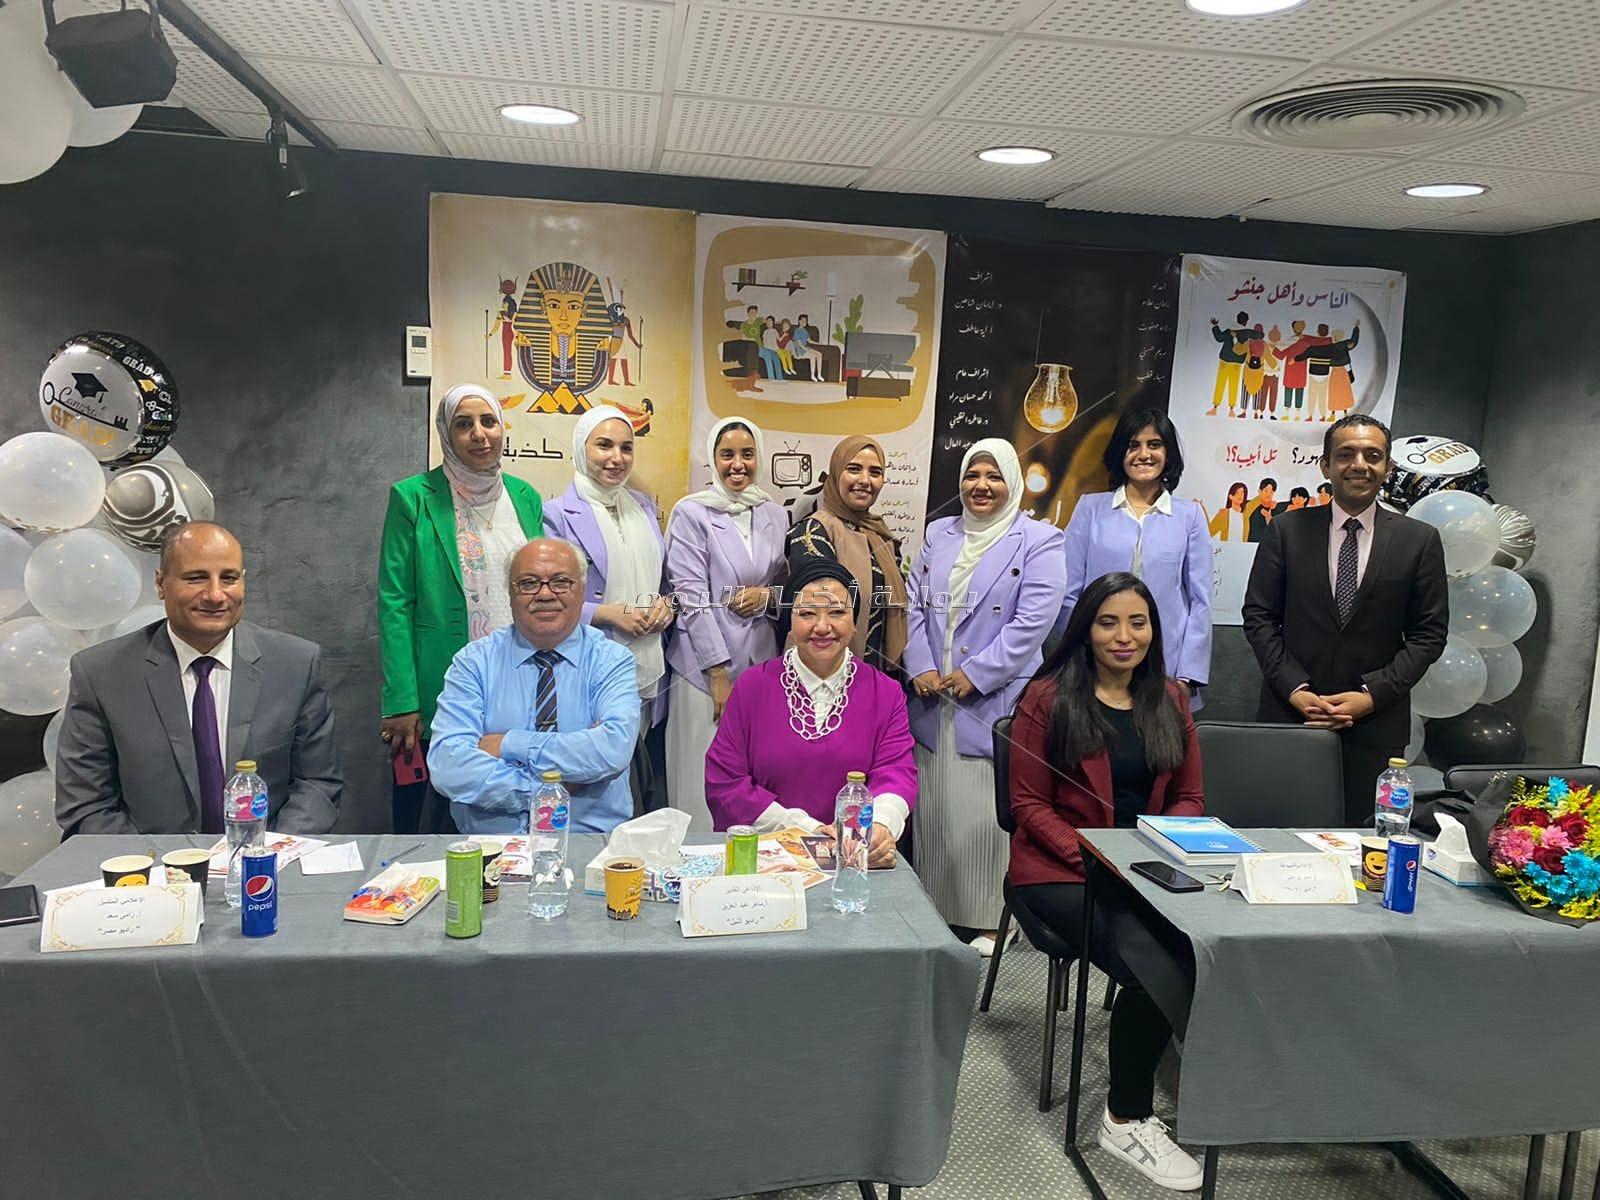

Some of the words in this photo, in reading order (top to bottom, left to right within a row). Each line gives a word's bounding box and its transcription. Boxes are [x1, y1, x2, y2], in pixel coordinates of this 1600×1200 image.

[1227, 276, 1265, 301] جنشو
[1267, 281, 1304, 306] وأهل
[1306, 288, 1349, 308] الناس
[502, 436, 564, 462] كذبة
[1263, 448, 1278, 464] تل
[248, 901, 273, 911] pepsi
